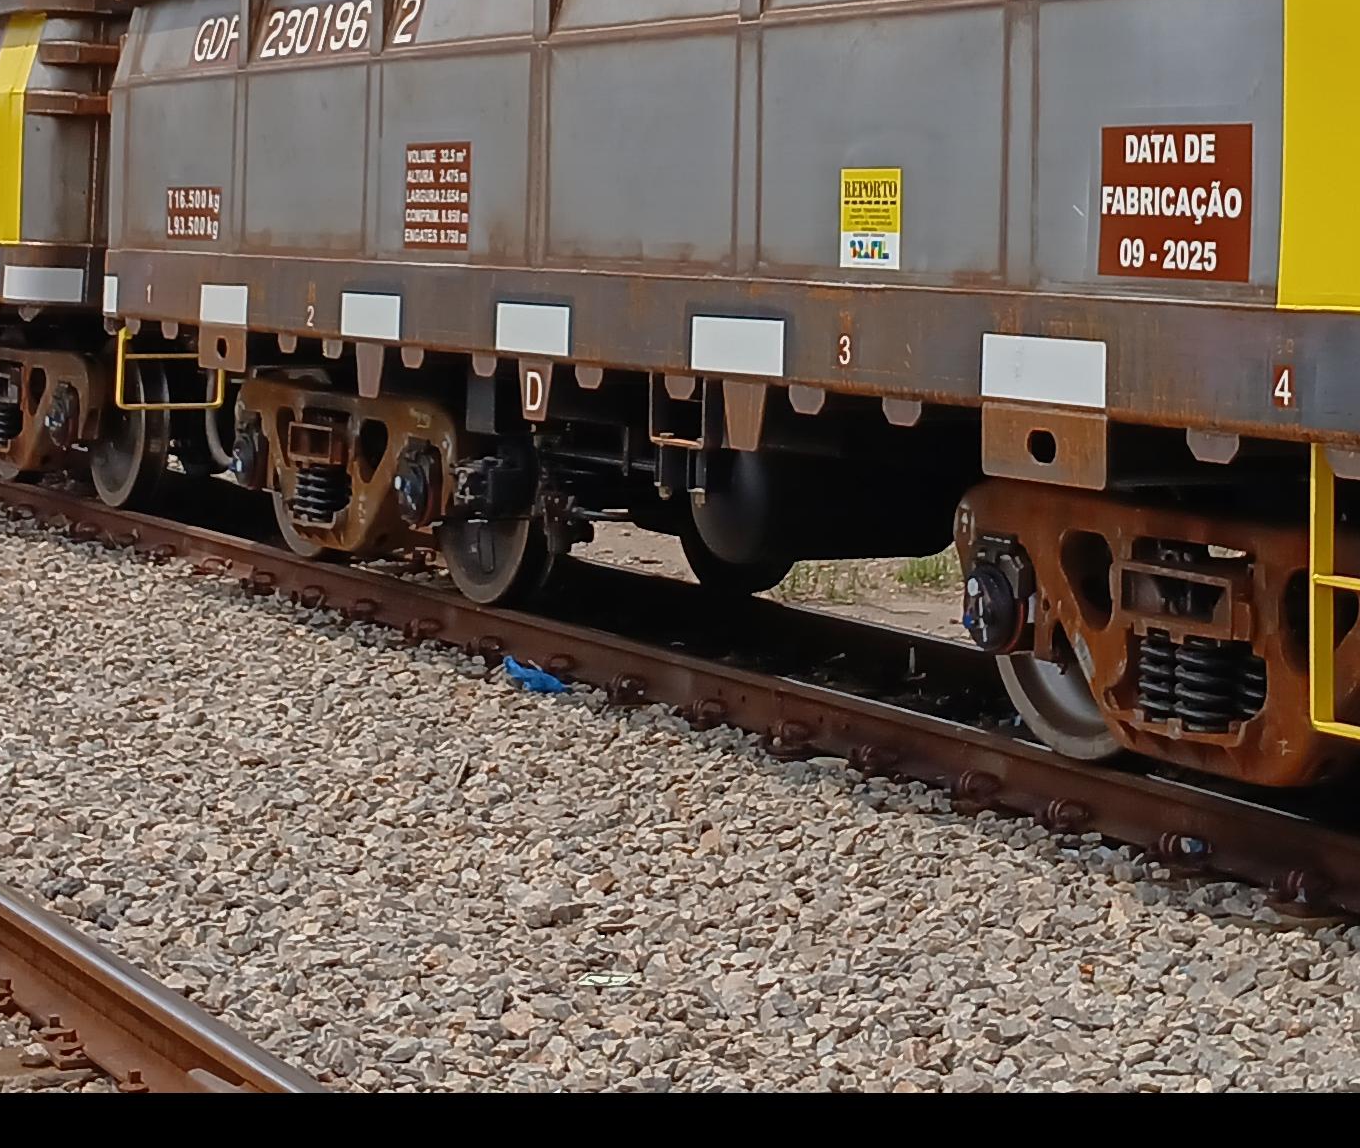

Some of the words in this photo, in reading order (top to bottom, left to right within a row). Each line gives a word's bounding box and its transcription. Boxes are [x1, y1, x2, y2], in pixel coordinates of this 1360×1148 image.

[260, 0, 372, 58] 230196
[1125, 134, 1178, 163] DATA
[1184, 133, 1216, 163] DE
[407, 169, 434, 183] ALTURA
[844, 180, 898, 198] REPORTO
[406, 189, 440, 203] LARGURA
[1101, 180, 1242, 225] FABRICAÇÃO
[404, 228, 438, 243] ENGATES
[1119, 238, 1145, 268] 09
[1162, 239, 1217, 271] 2025
[306, 305, 315, 327] 2
[839, 335, 851, 365] 3
[526, 371, 543, 411] D
[1274, 369, 1292, 406] 4
